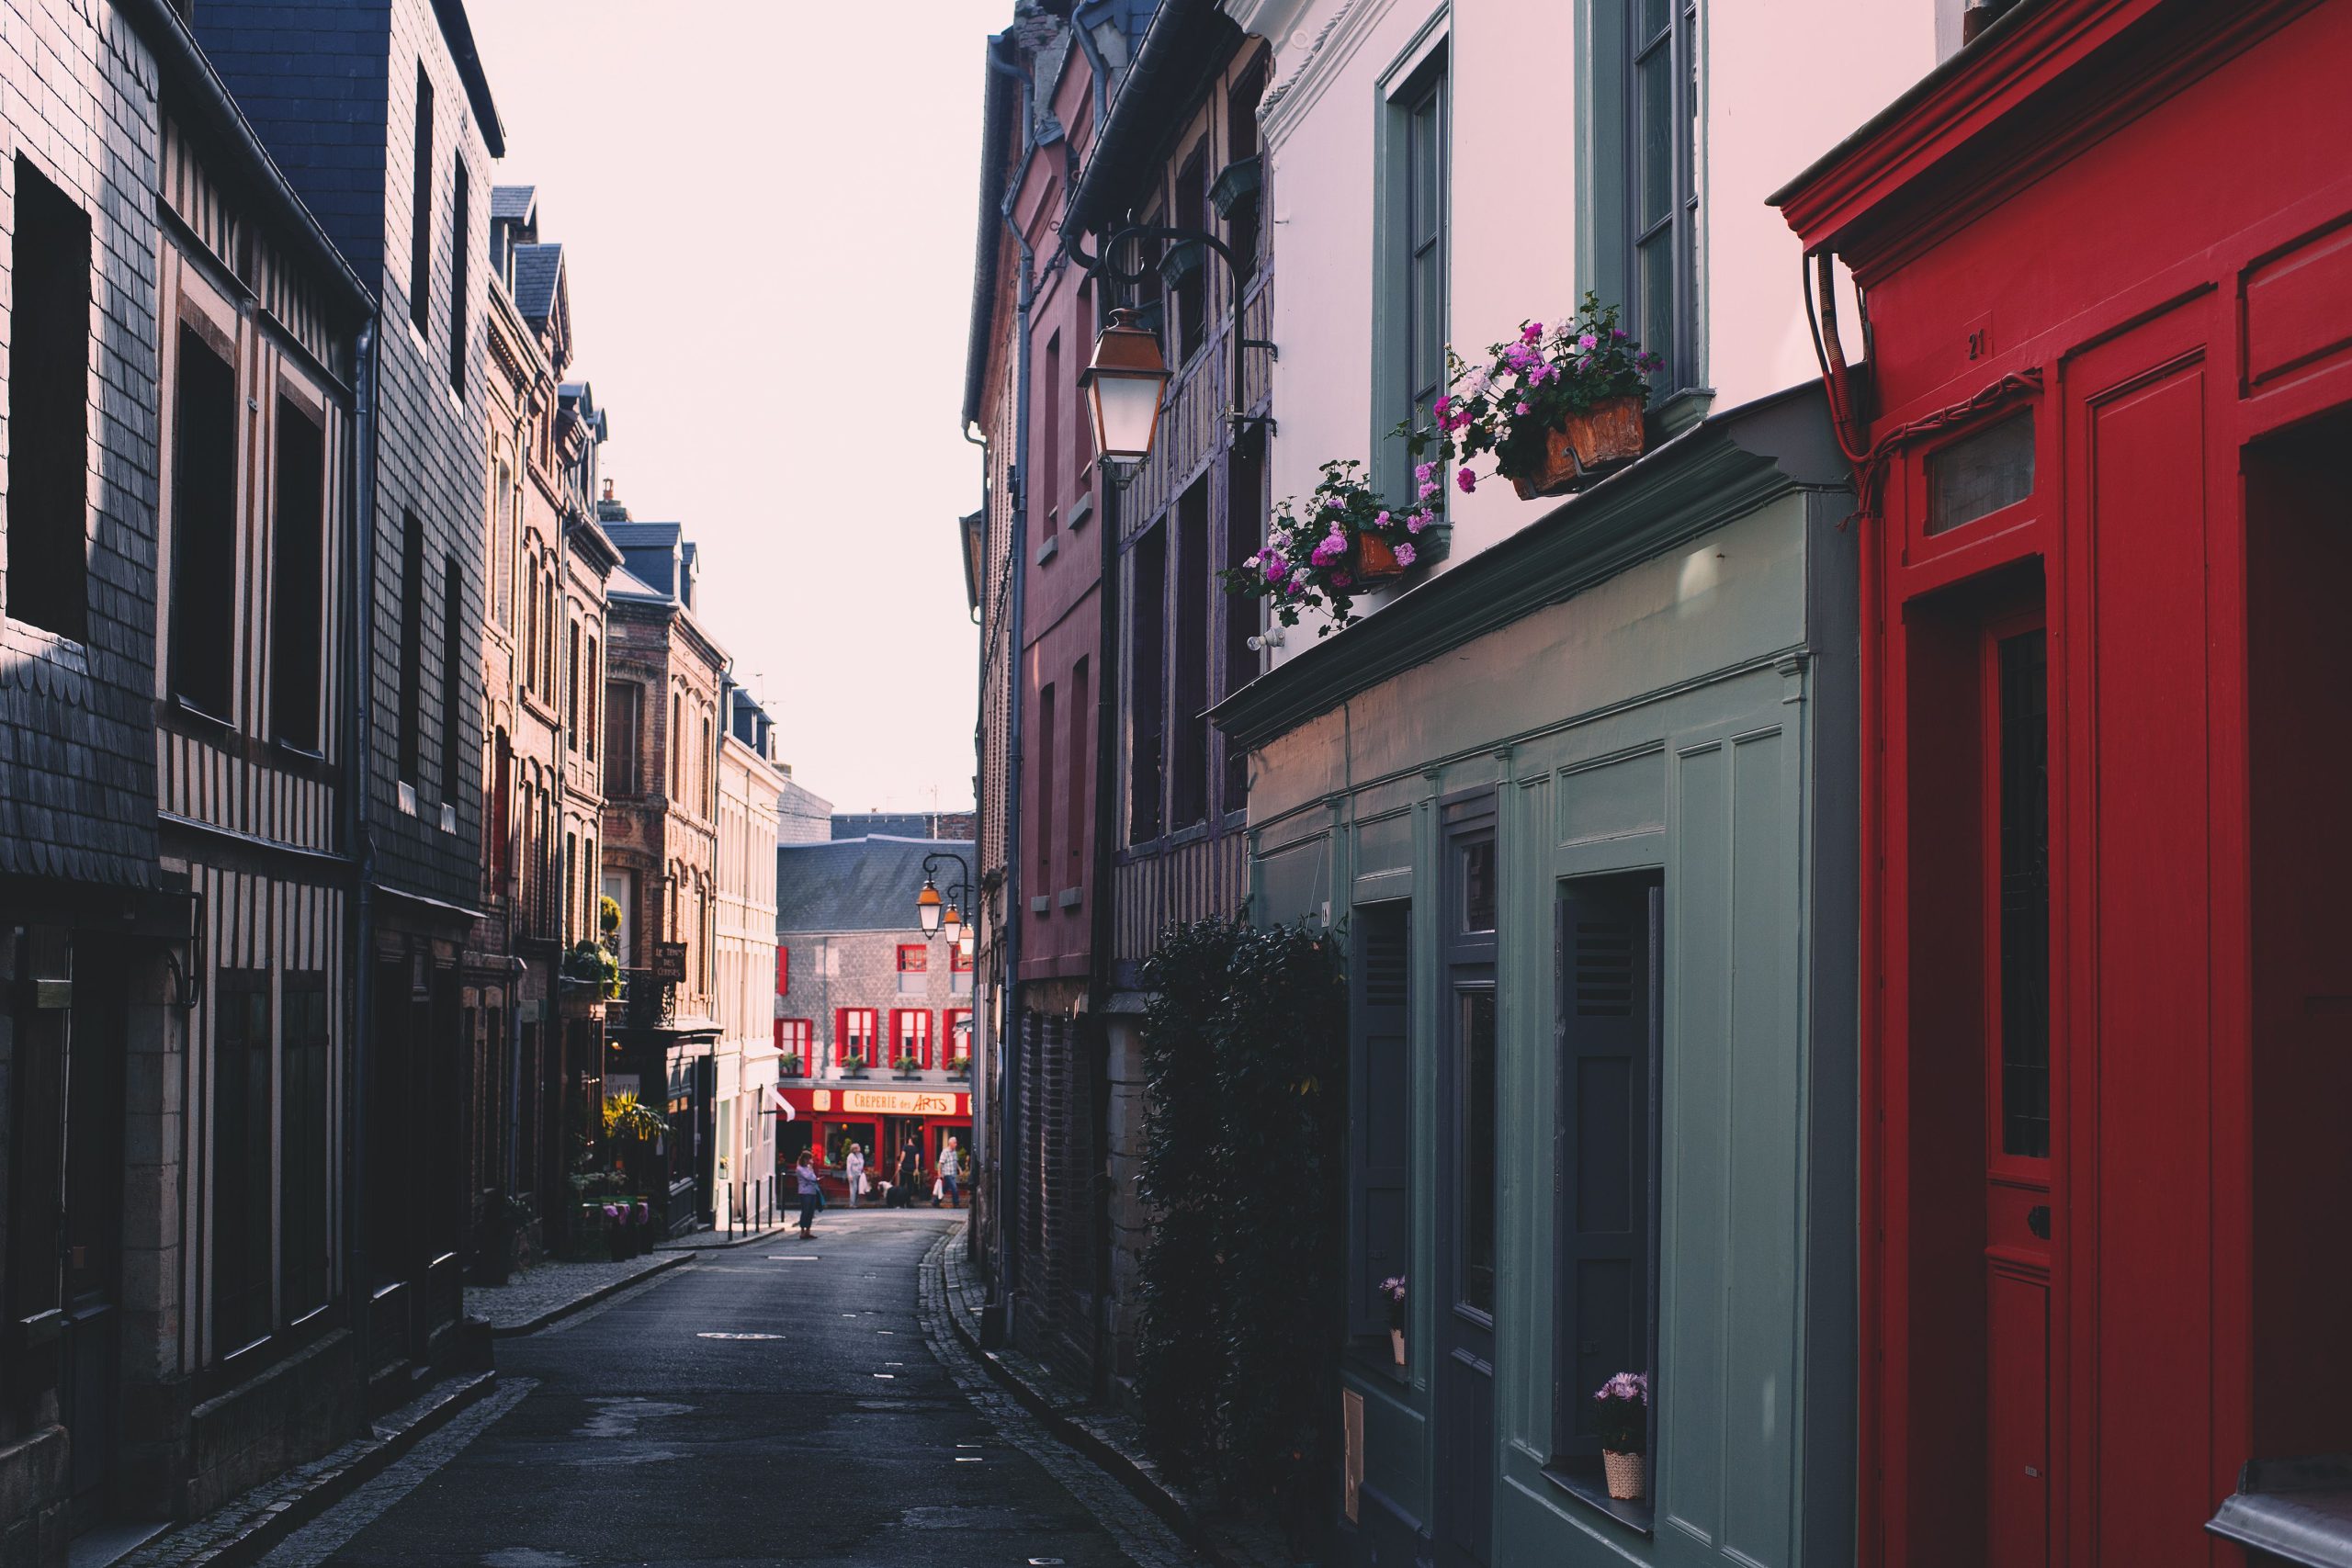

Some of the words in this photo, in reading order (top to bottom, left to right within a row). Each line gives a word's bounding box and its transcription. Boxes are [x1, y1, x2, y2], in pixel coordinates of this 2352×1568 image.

[1968, 328, 1984, 360] 21
[899, 1100, 910, 1109] des
[911, 1094, 946, 1111] ARTS
